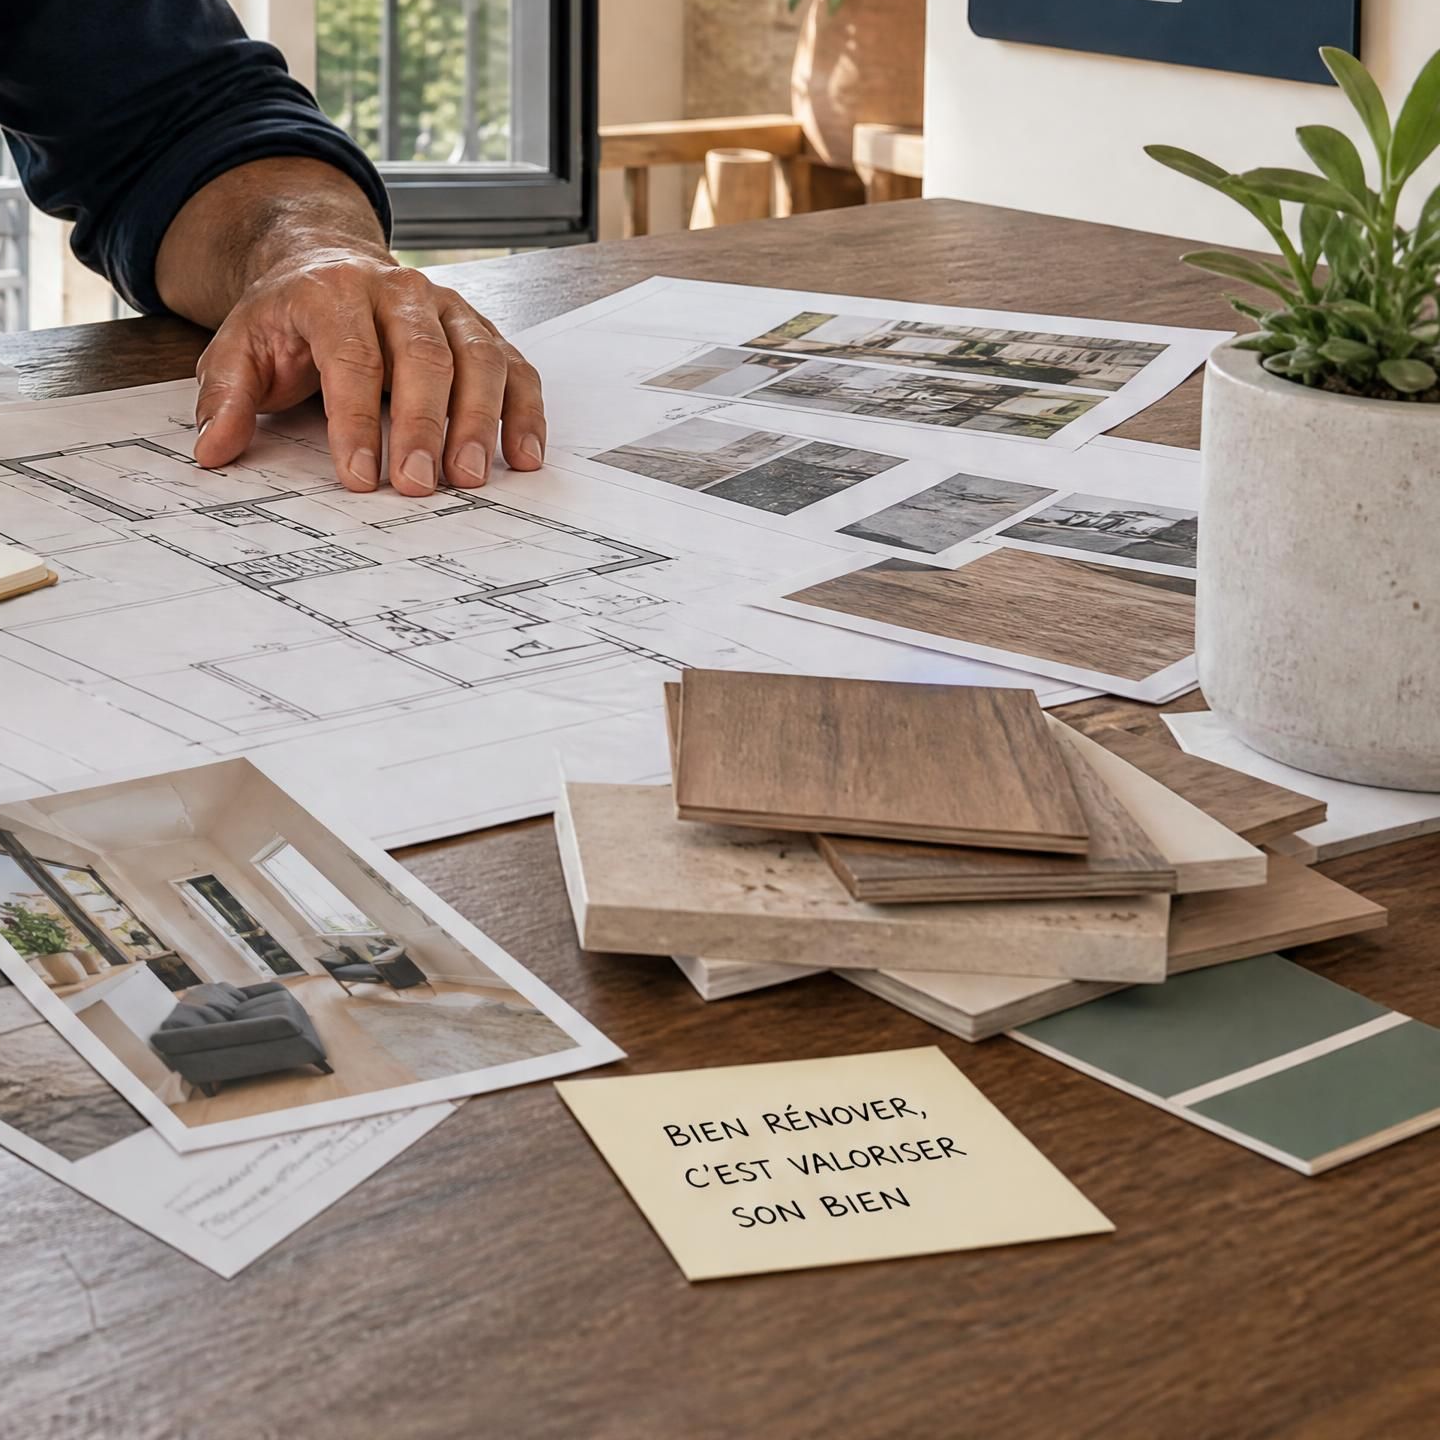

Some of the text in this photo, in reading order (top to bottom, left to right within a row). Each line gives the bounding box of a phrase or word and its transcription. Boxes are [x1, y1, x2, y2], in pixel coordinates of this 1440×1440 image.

[662, 1097, 927, 1147] BIEN RÉNOVER,
[685, 1136, 967, 1189] C'EST VALORISER
[731, 1187, 911, 1228] SON BIEN
